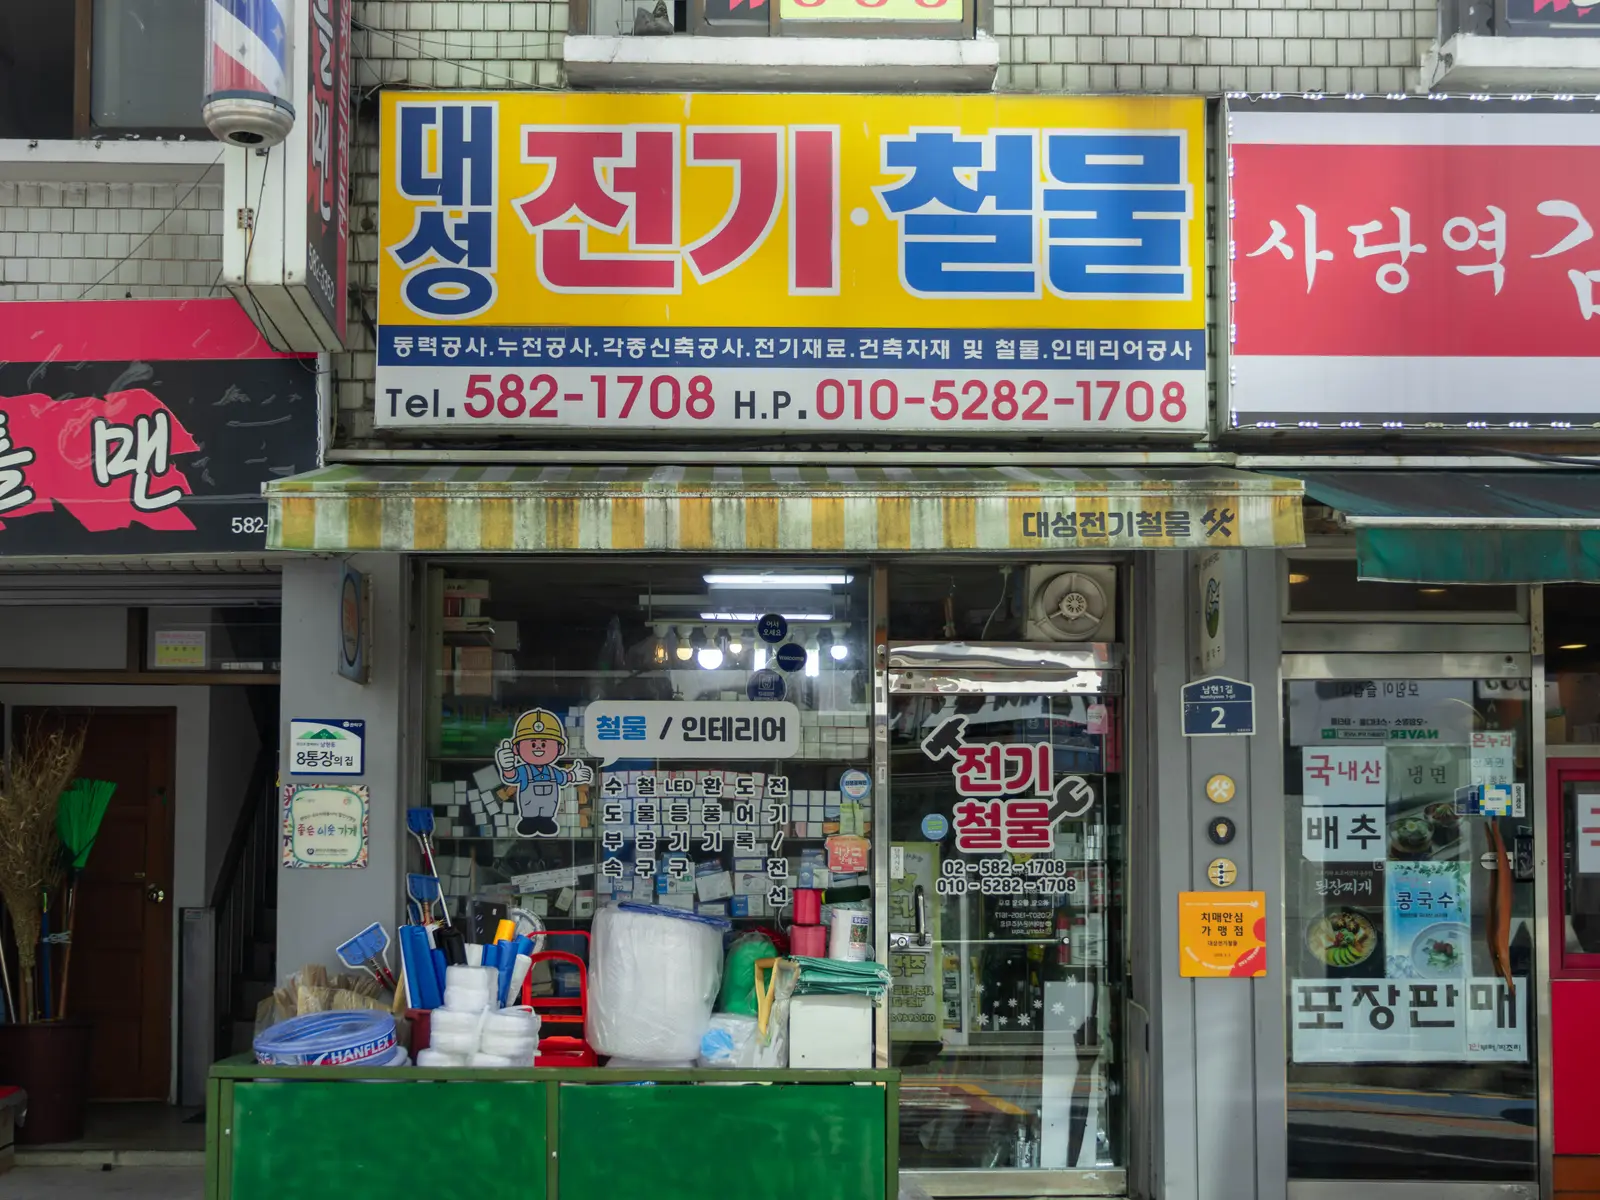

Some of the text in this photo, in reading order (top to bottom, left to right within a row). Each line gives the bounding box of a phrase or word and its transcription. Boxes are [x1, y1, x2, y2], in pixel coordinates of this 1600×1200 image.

[386, 101, 499, 320] 대성
[1246, 204, 1507, 297] 사당역
[963, 338, 983, 360] 및
[385, 373, 1187, 423] Tel. 582-1708 H.P. 010-5282-1708
[1022, 511, 1191, 538] 대성전기철물
[1202, 685, 1233, 694] 남현1길
[1211, 706, 1226, 728] 2
[596, 715, 647, 741] 철물
[681, 716, 786, 742] 인테리어
[1472, 733, 1512, 748] 온누리
[296, 750, 353, 767] 8통장의 집
[955, 744, 1051, 793] 전기
[1305, 755, 1381, 786] 국내산
[1408, 765, 1447, 785] 냉면
[297, 823, 358, 837] 좋은 이웃 가게
[955, 801, 1051, 849] 철물
[1307, 813, 1382, 850] 배추
[943, 860, 1066, 876] 02-582-1708
[936, 879, 1077, 894] 010-5282-1708
[1315, 878, 1373, 896] 된장찌개
[1396, 891, 1455, 911] 콩국수
[1201, 912, 1243, 924] 치매안심
[1297, 983, 1517, 1031] 포장판매
[330, 1037, 391, 1064] HANFLEX
